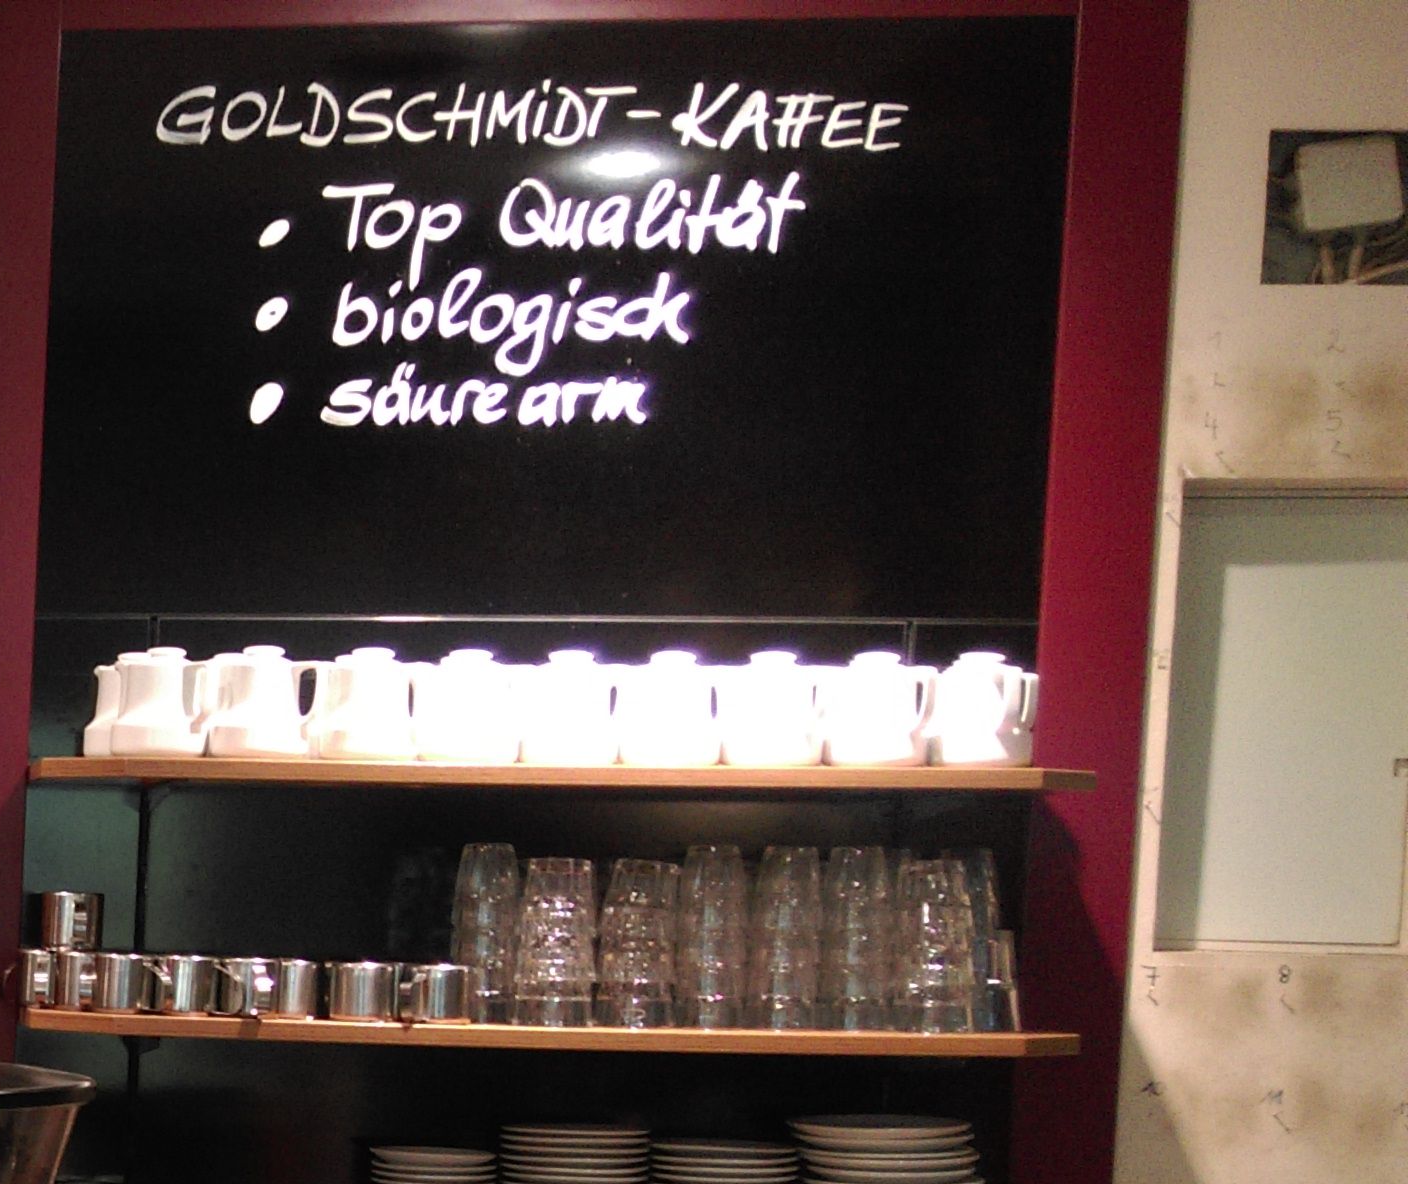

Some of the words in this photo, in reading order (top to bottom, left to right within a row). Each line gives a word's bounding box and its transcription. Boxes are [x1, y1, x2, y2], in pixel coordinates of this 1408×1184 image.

[323, 183, 461, 290] Top
[500, 173, 806, 256] Qualität
[333, 271, 693, 376] biologisch
